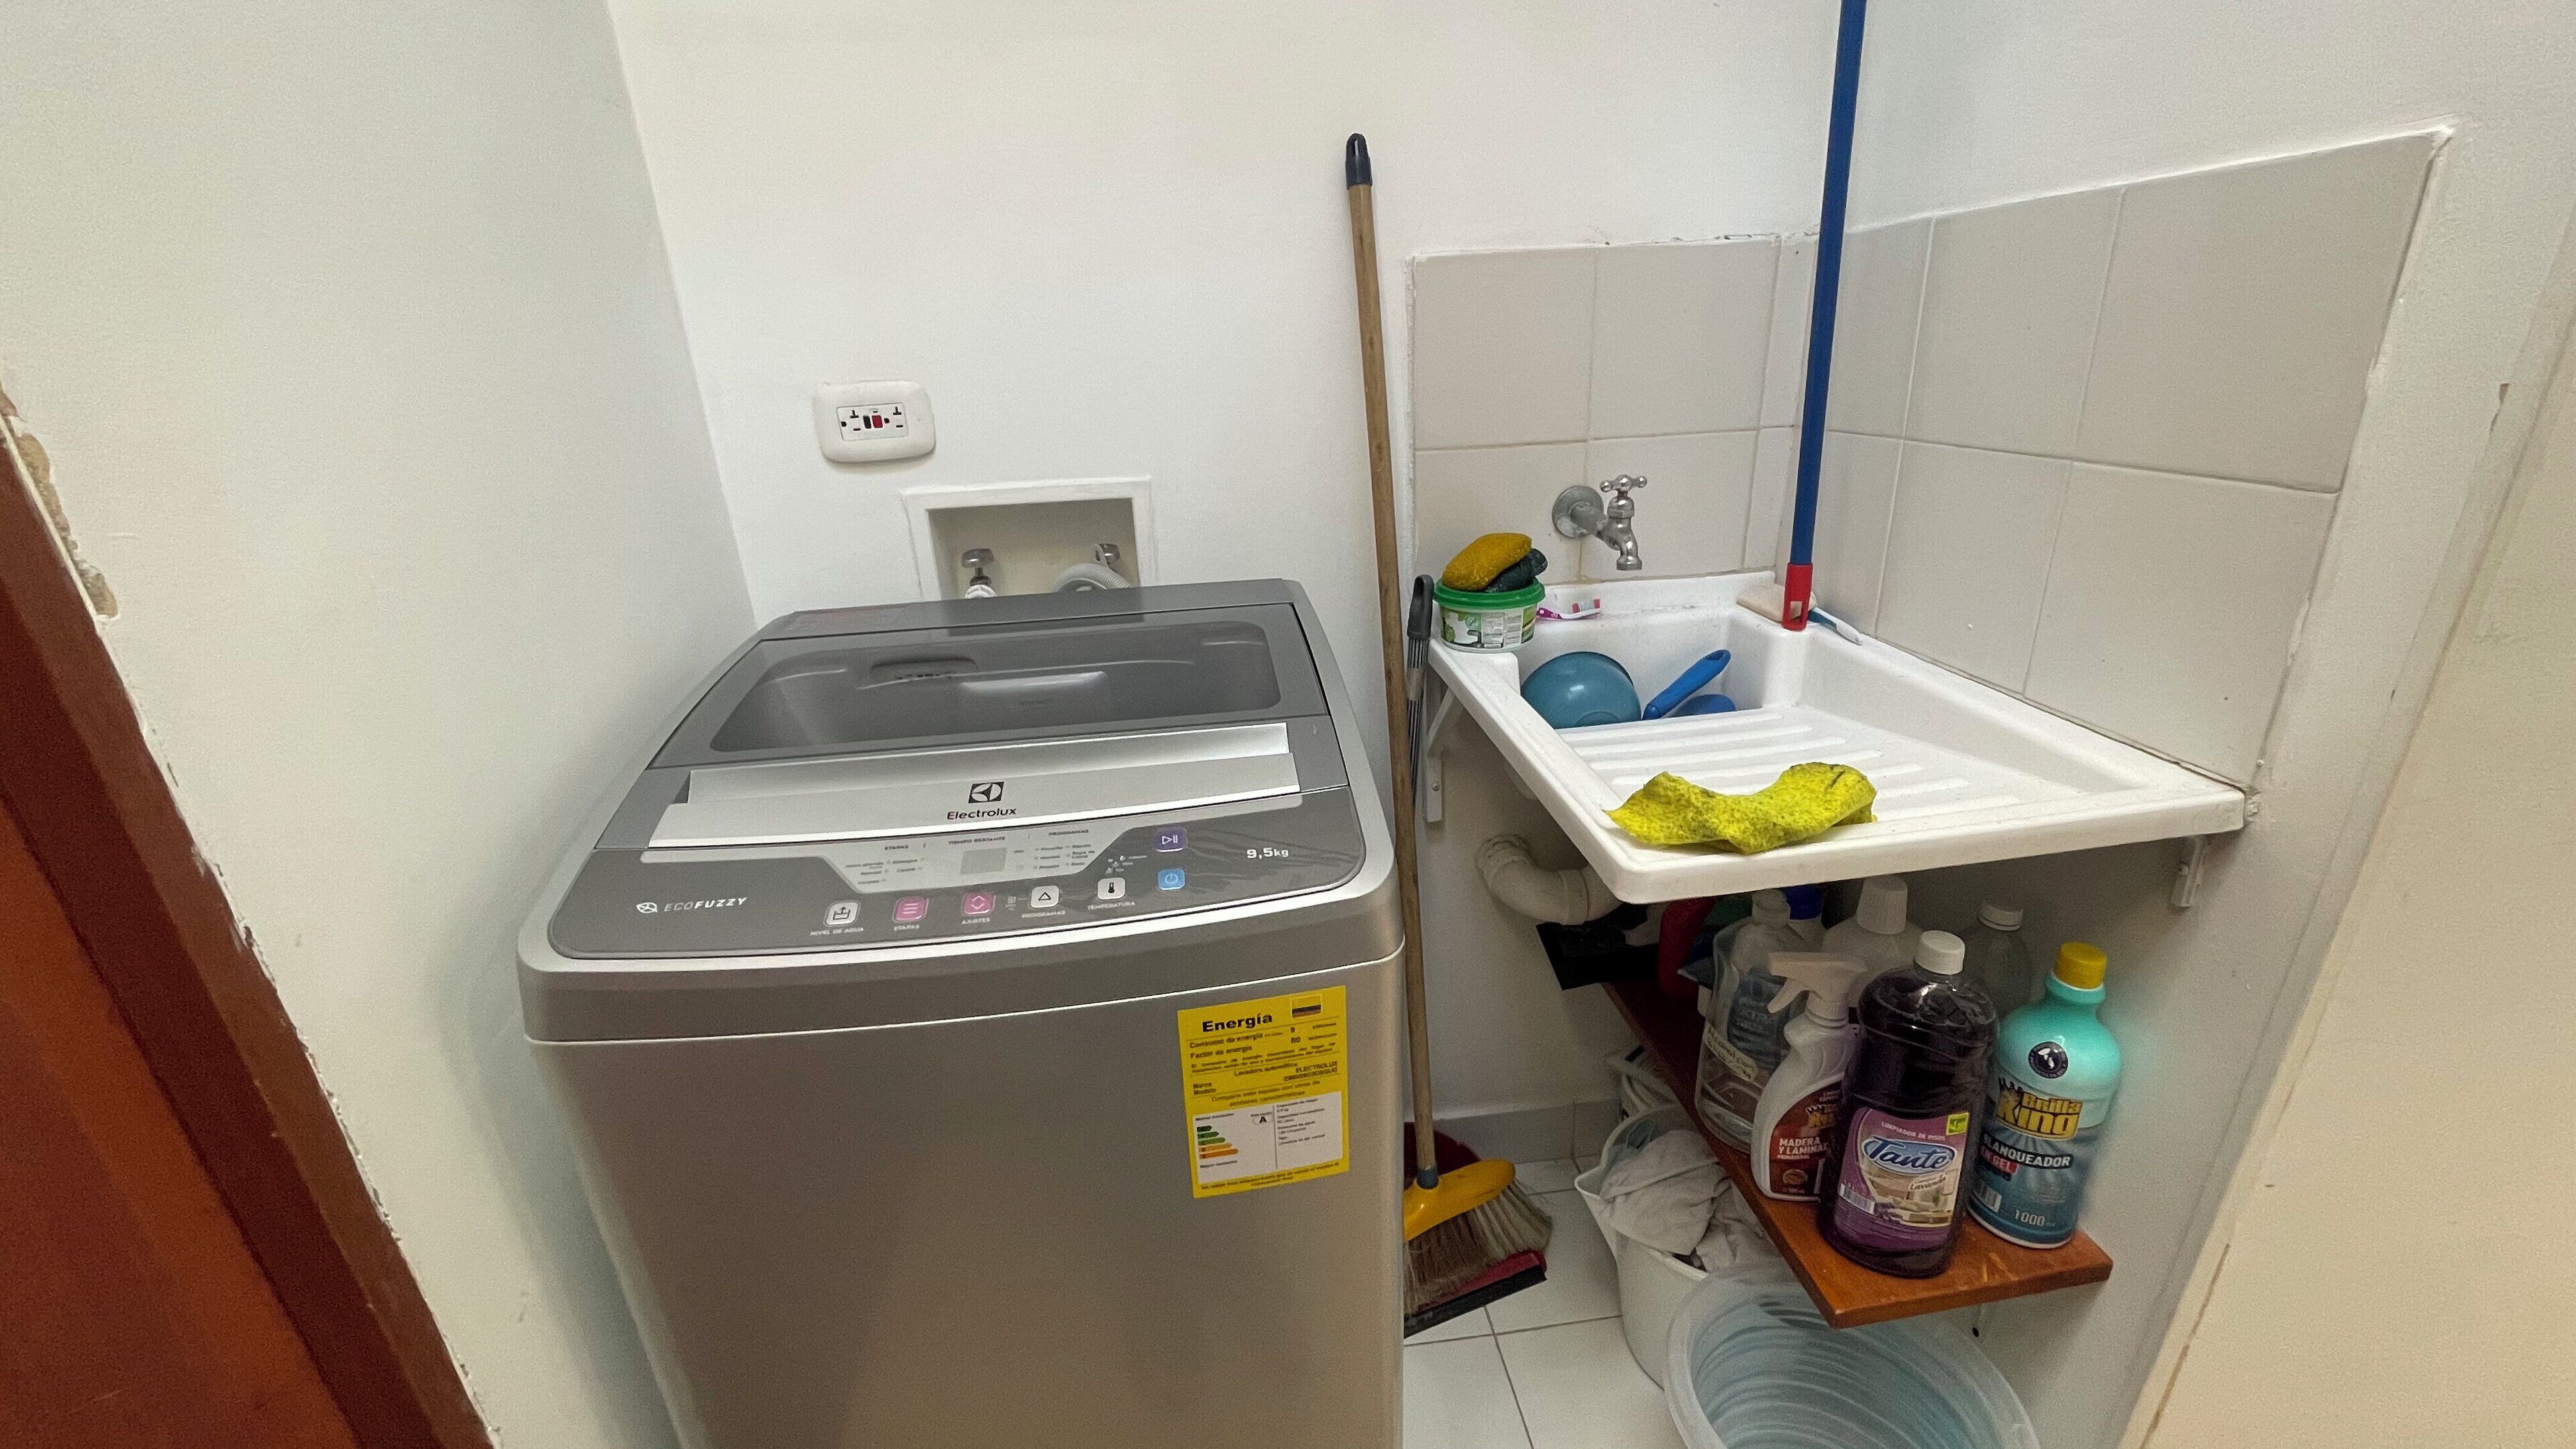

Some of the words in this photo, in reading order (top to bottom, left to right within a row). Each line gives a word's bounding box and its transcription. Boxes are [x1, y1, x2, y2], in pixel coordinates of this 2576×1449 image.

[947, 808, 1016, 820] Electrolux
[1246, 847, 1289, 859] 9,5kg
[664, 897, 747, 912] ECOFUZZY
[1087, 901, 1135, 910] TEMPERATURA
[1022, 910, 1066, 918] PROGRAMAS
[1202, 1013, 1273, 1032] Energía
[1189, 1038, 1224, 1049] Consumo
[1190, 1051, 1214, 1059] Factor
[1193, 1087, 1216, 1095] Modelo
[1881, 1121, 1917, 1138] LIMPIADOR
[1779, 1136, 1821, 1146] MADERA
[1778, 1146, 1784, 1154] Y
[1992, 1155, 2012, 1172] GEL
[1911, 1175, 1946, 1190] Lavanda
[2015, 1209, 2045, 1227] 1000
